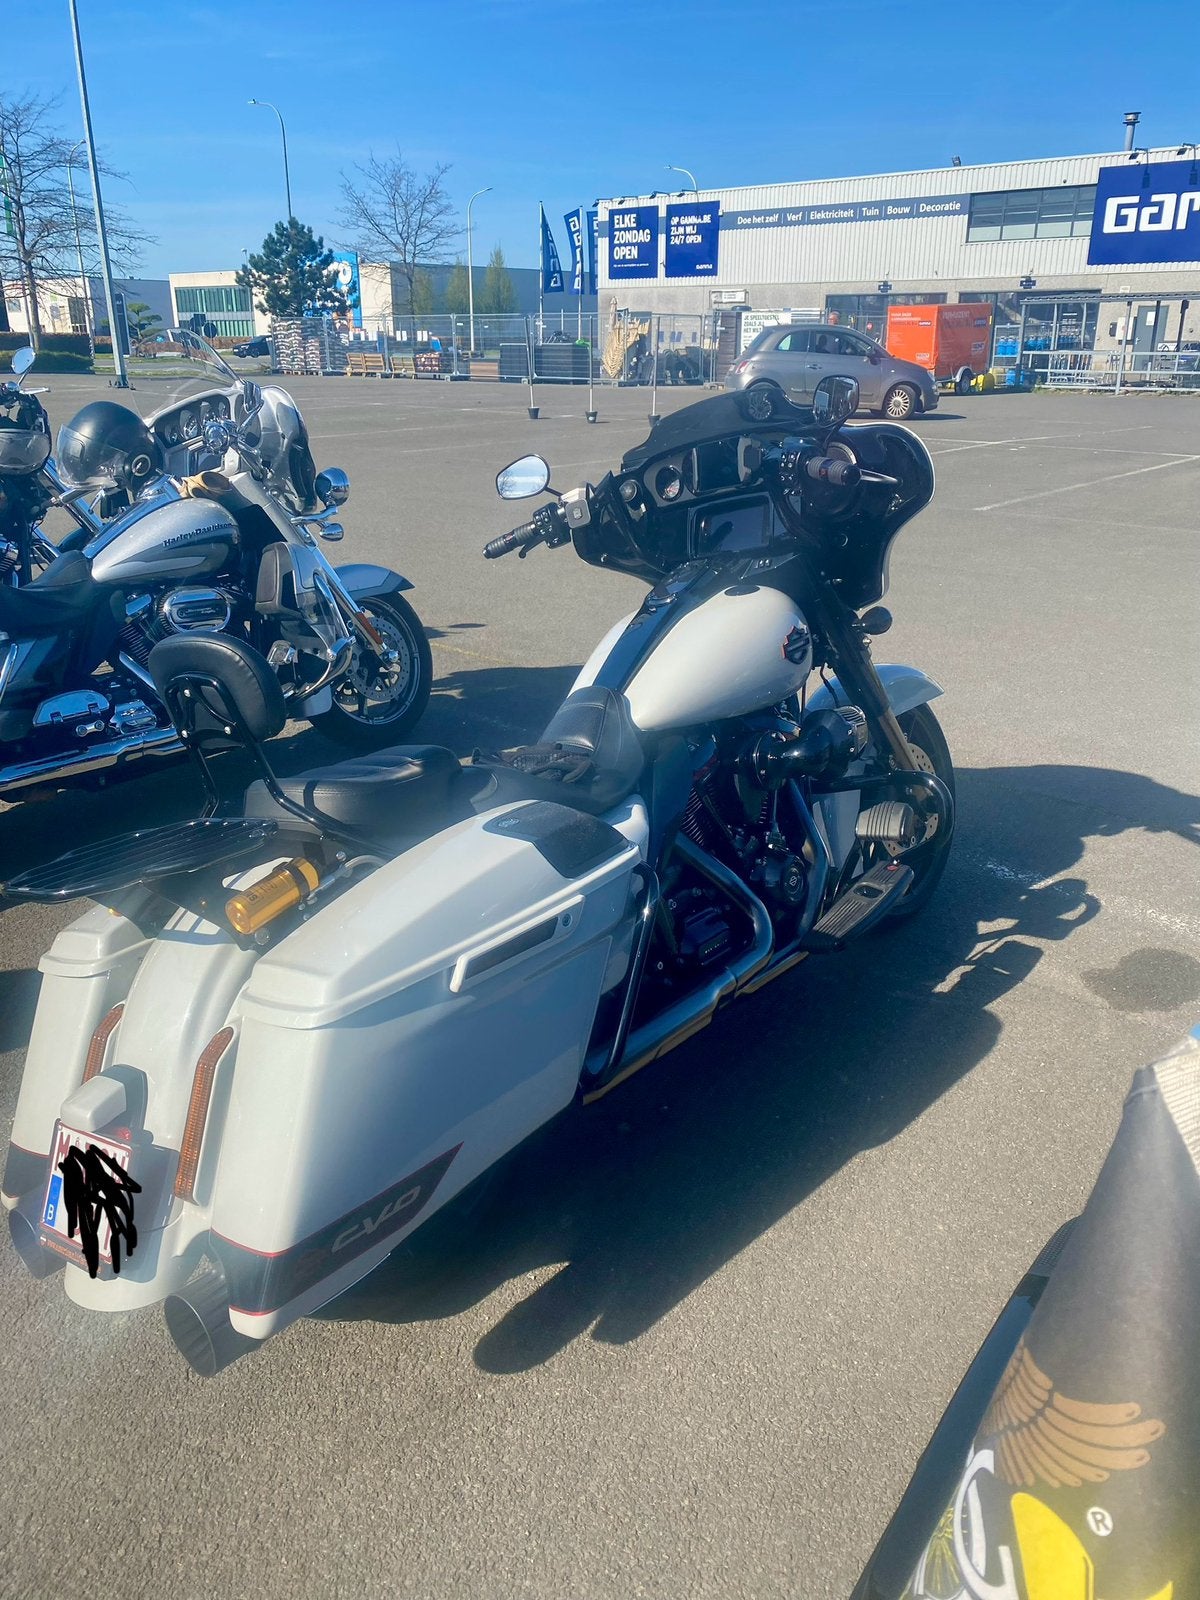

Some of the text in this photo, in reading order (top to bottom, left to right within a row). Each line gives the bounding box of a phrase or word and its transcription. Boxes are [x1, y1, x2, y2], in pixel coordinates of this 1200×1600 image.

[614, 213, 637, 228] ELKE
[671, 216, 679, 225] OP
[737, 201, 961, 225] Doe het zelf Verf Elektriciteit Tuin Bouw Decoratie
[613, 229, 651, 244] ZONDAG
[670, 225, 697, 235] ZIJN WIJ
[670, 235, 702, 245] 24/7 OPEN
[613, 246, 638, 260] OPEN
[47, 1203, 54, 1221] B
[332, 1185, 422, 1254] CVO
